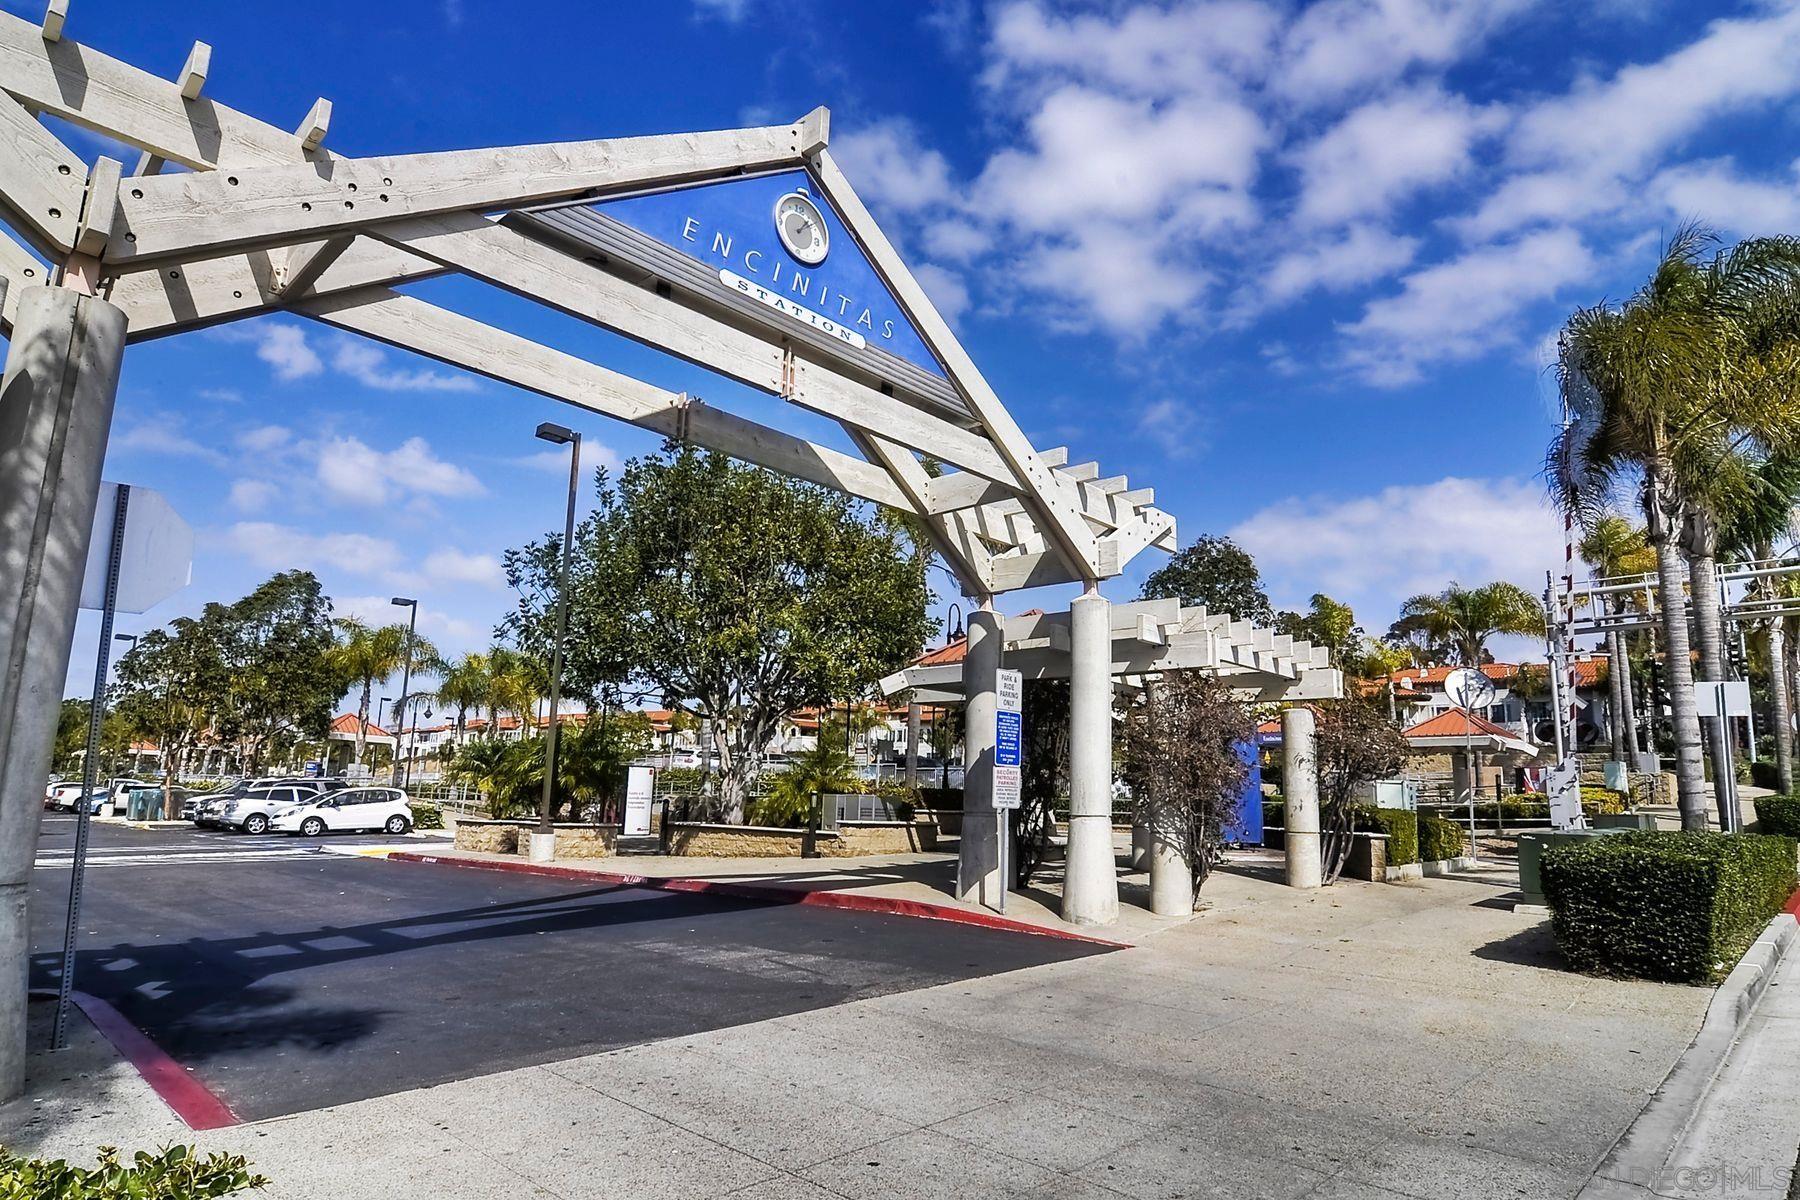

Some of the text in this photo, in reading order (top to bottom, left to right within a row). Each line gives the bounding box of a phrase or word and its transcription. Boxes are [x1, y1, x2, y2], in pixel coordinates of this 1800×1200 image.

[794, 204, 804, 216] 12
[682, 216, 895, 340] ENCINITAS
[737, 279, 852, 342] STATION
[1001, 674, 1013, 682] PARK
[1003, 682, 1015, 691] RIDE
[999, 690, 1019, 699] PARKING
[1003, 699, 1015, 707] ONLY
